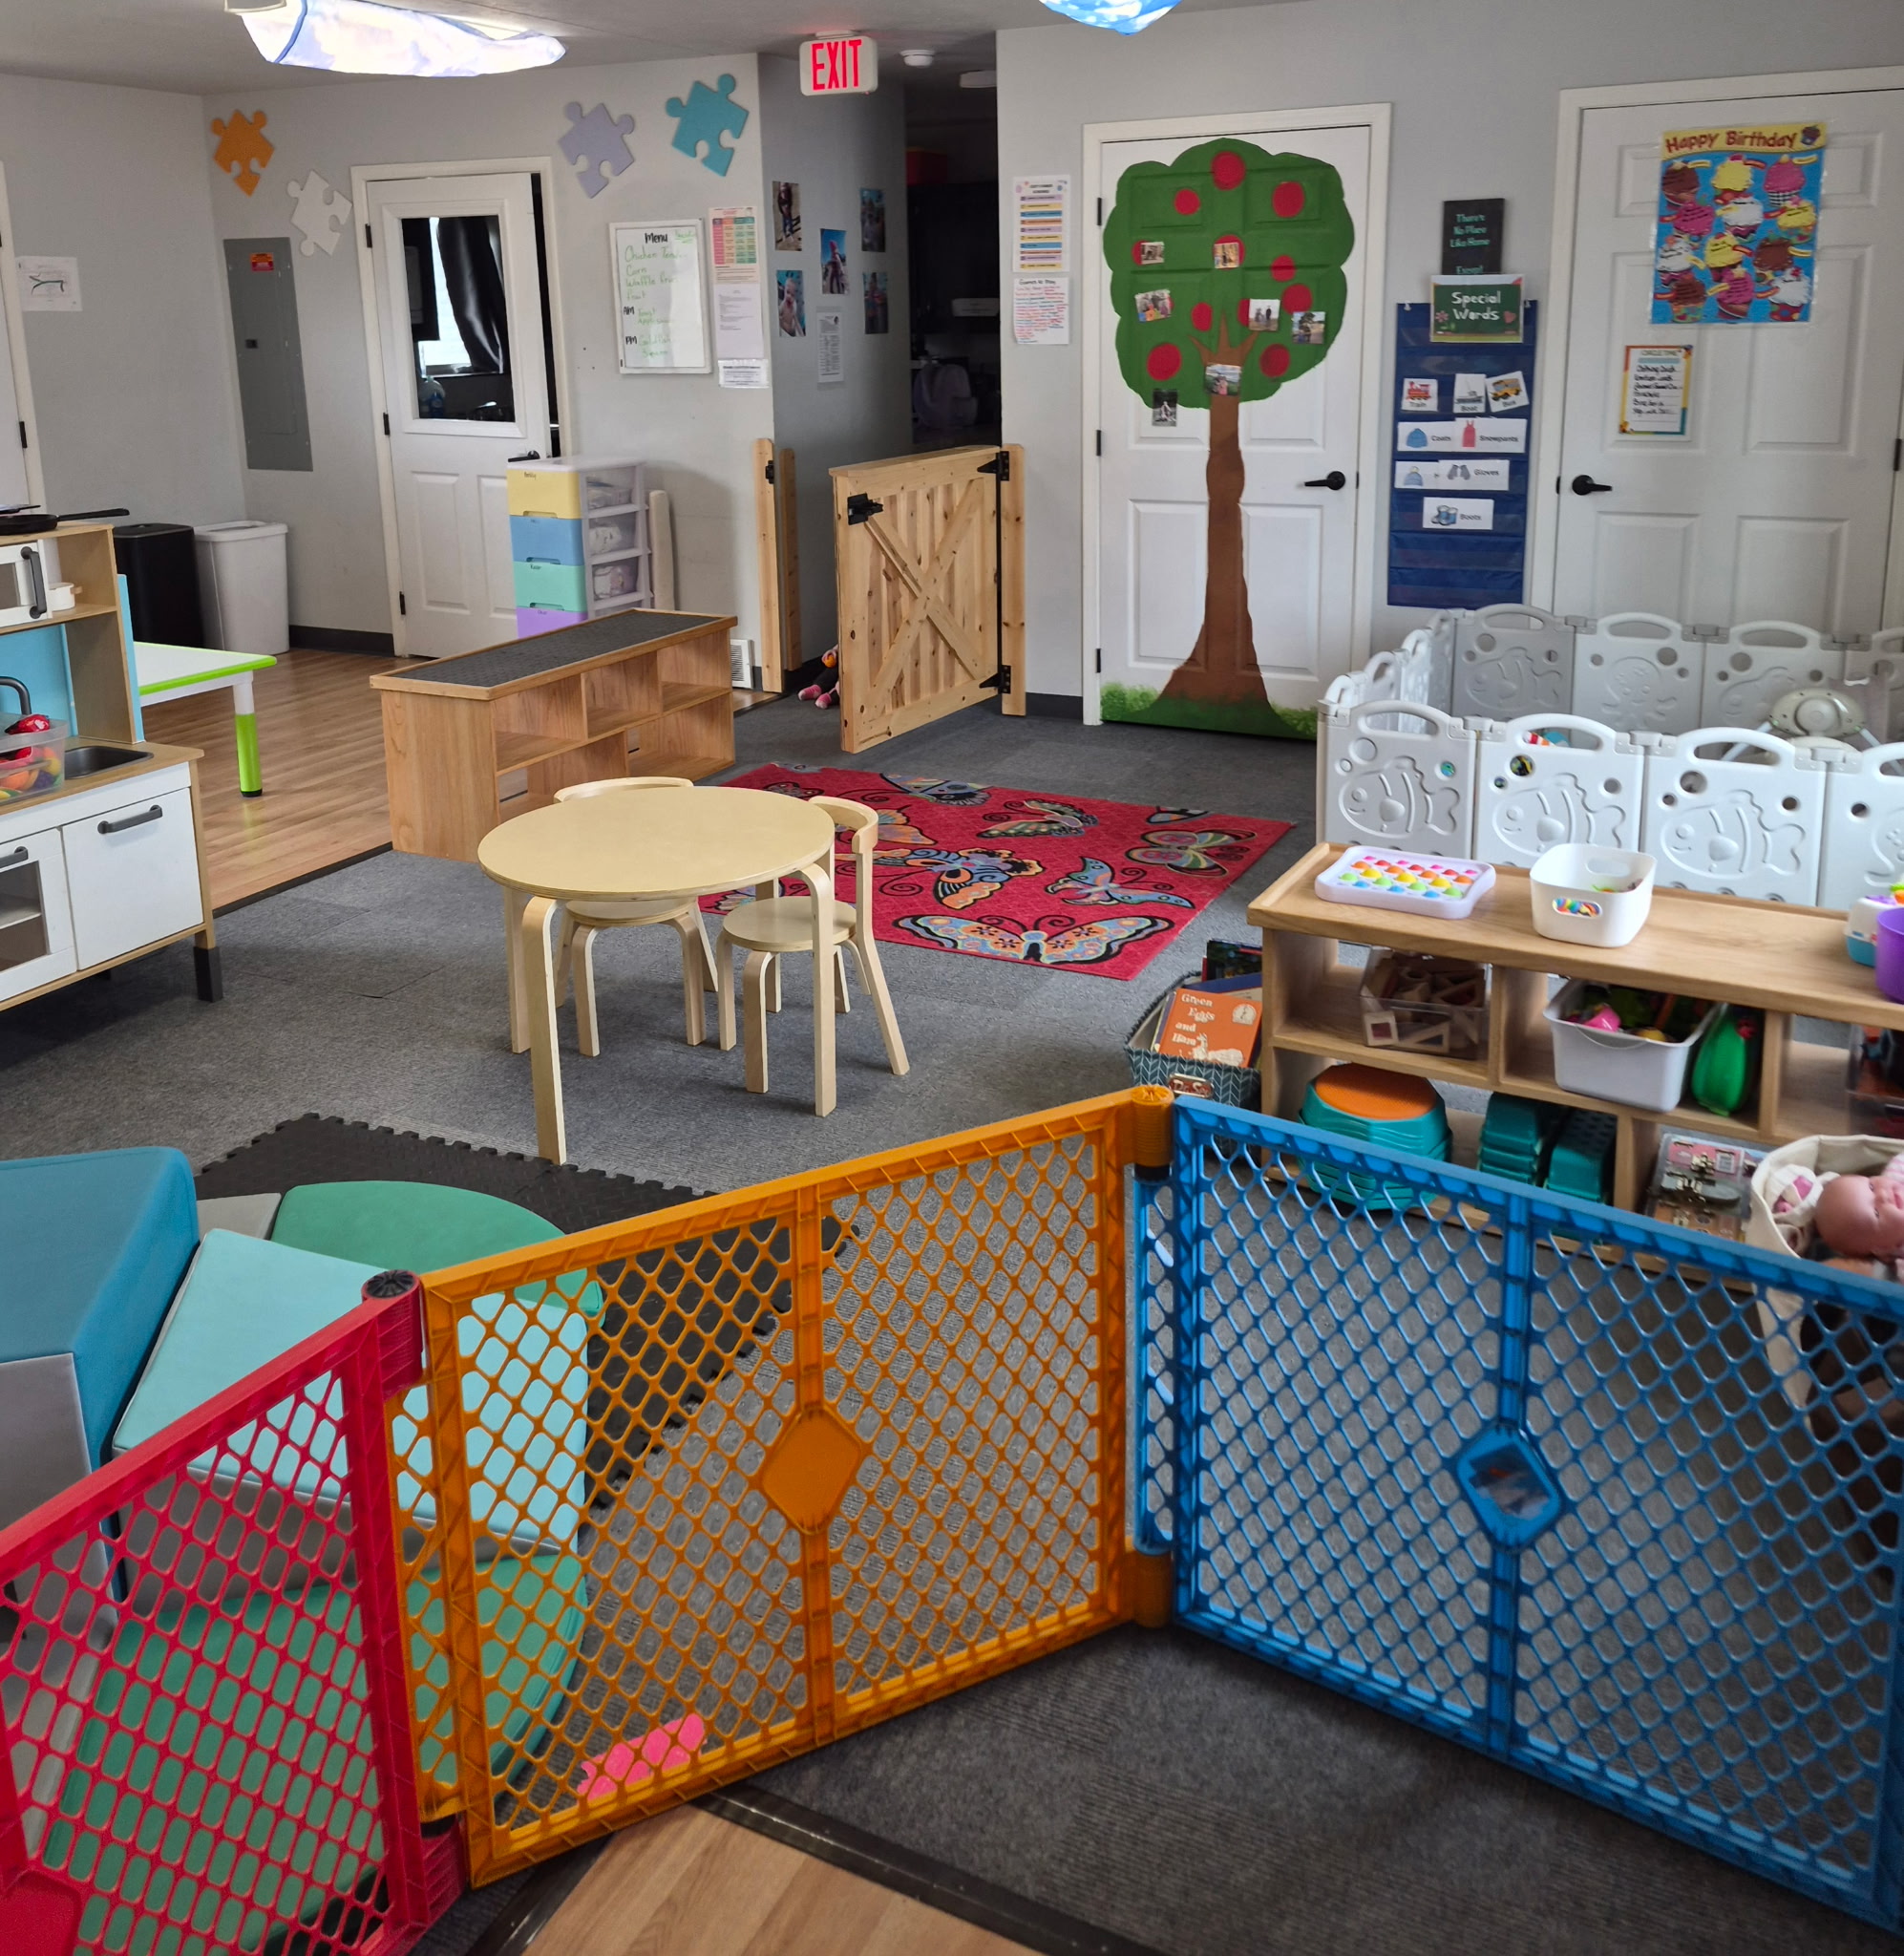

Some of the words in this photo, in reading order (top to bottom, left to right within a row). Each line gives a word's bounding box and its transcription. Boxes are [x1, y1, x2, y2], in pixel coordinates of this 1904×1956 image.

[812, 39, 862, 91] EXIT
[1665, 132, 1720, 154] Happy
[1725, 130, 1798, 149] Birthday
[645, 232, 668, 244] Menu
[625, 244, 657, 263] Chicken
[626, 265, 647, 277] Corn
[1451, 290, 1502, 308] Special
[624, 306, 635, 316] AM
[1452, 307, 1500, 321] Words
[625, 335, 638, 345] PM
[1479, 435, 1519, 443] Snowpants
[1473, 468, 1499, 477] Gloves
[1459, 513, 1482, 521] Boots
[1180, 992, 1214, 1008] Green
[1188, 1007, 1216, 1024] Eggs
[1175, 1022, 1196, 1032] and
[1172, 1032, 1197, 1047] Ham
